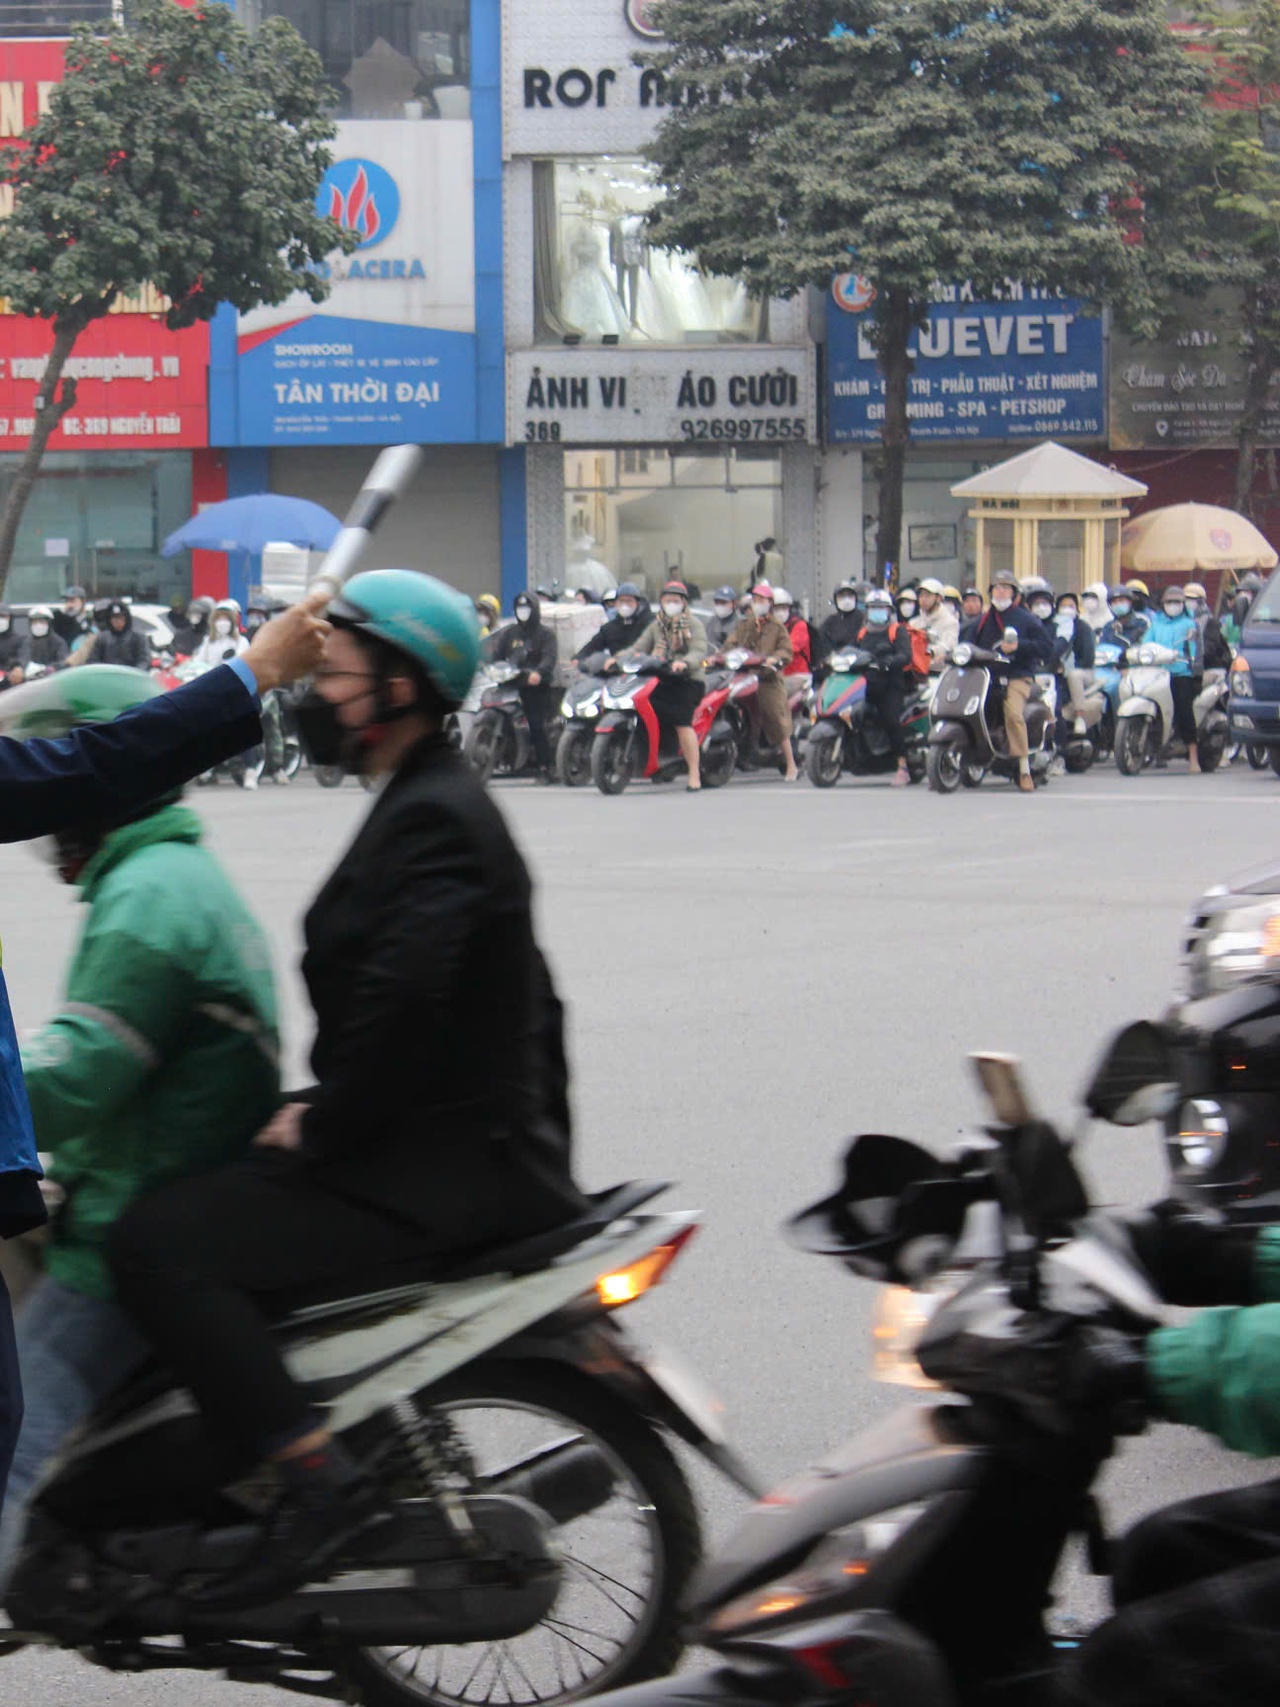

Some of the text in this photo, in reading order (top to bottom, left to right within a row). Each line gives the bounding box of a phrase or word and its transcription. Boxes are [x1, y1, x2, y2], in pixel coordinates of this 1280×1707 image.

[274, 344, 354, 356] SHOWROOM
[274, 377, 440, 408] TÂN THỜI ĐẠI
[526, 366, 589, 408] ẢNH
[677, 370, 716, 408] ÁO
[910, 378, 931, 397] TRỊ
[1025, 371, 1048, 391] XÉT
[1050, 370, 1098, 392] NGHIỆM
[866, 398, 1067, 420] GRMING SPA PETSHOP
[525, 420, 561, 442] 369
